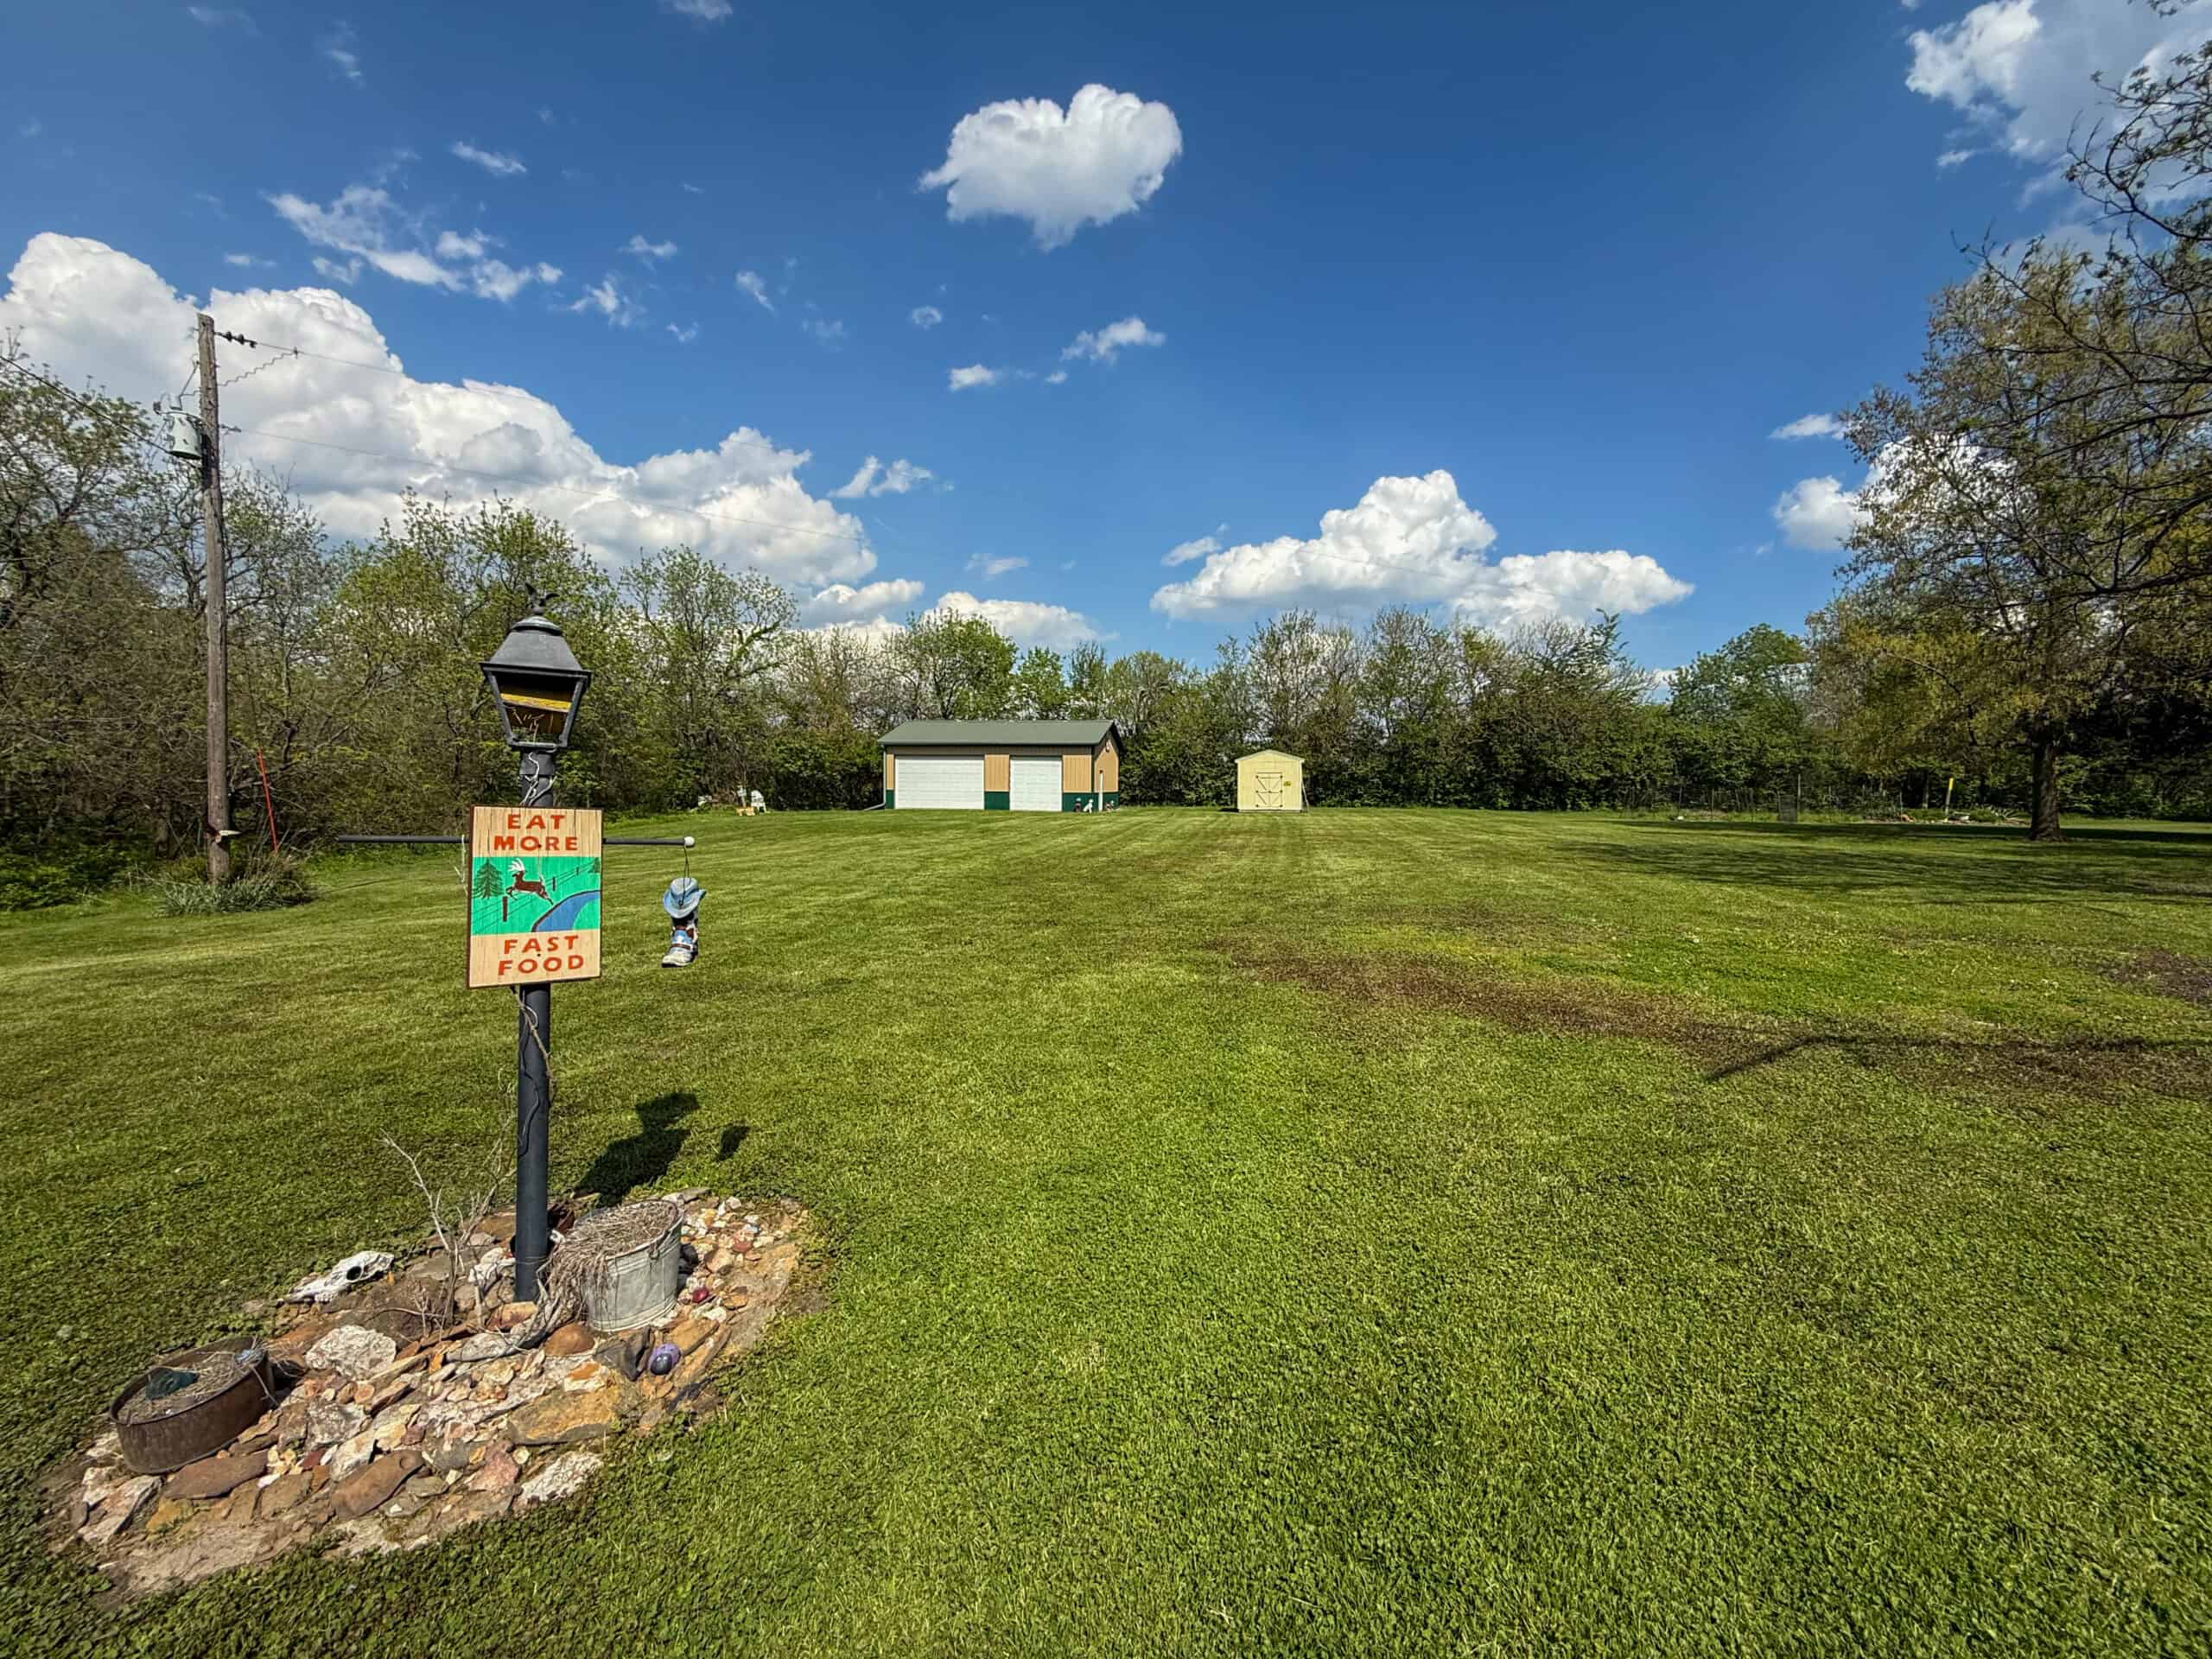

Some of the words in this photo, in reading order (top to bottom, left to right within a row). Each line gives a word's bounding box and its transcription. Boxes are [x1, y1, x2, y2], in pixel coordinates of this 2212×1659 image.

[507, 814, 566, 830] EAT
[493, 836, 579, 851] MORE
[504, 935, 579, 955] FAST
[498, 955, 584, 976] FOOD
